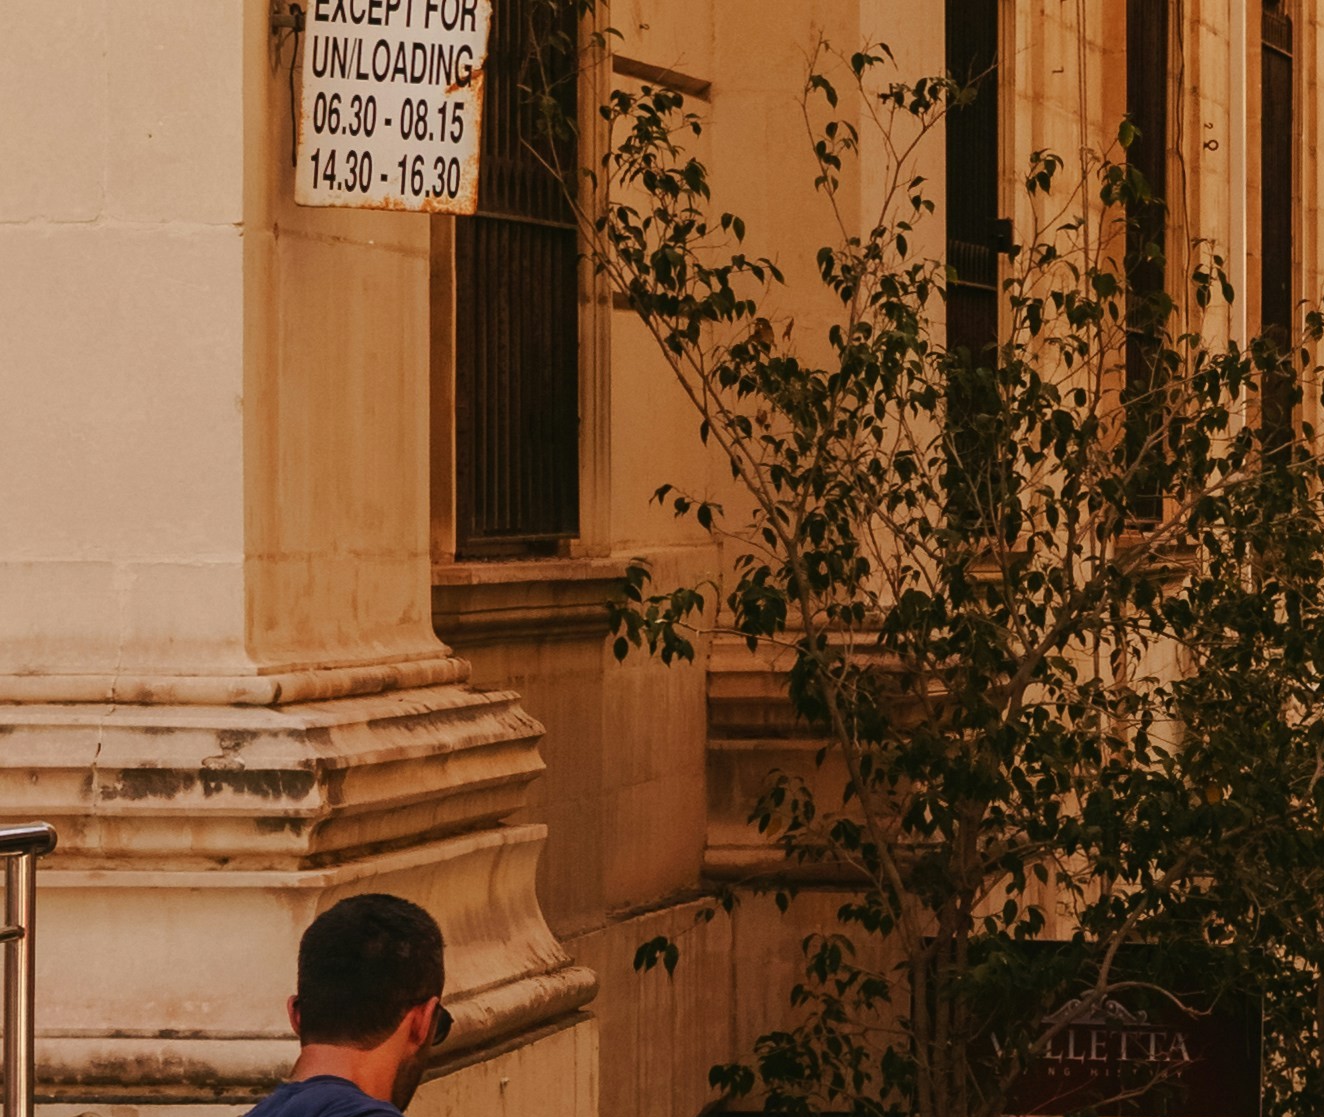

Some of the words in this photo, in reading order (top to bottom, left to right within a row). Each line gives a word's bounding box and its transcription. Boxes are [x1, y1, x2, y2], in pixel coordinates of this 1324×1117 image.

[314, 0, 412, 27] EXCEPT
[424, 0, 477, 32] FOR
[312, 35, 474, 88] UN/LOADING
[313, 91, 377, 137] 06.30
[400, 97, 465, 144] 08.15
[310, 148, 373, 194] 14.30
[397, 154, 461, 199] 16.30
[990, 1030, 1193, 1064] VLLETTA
